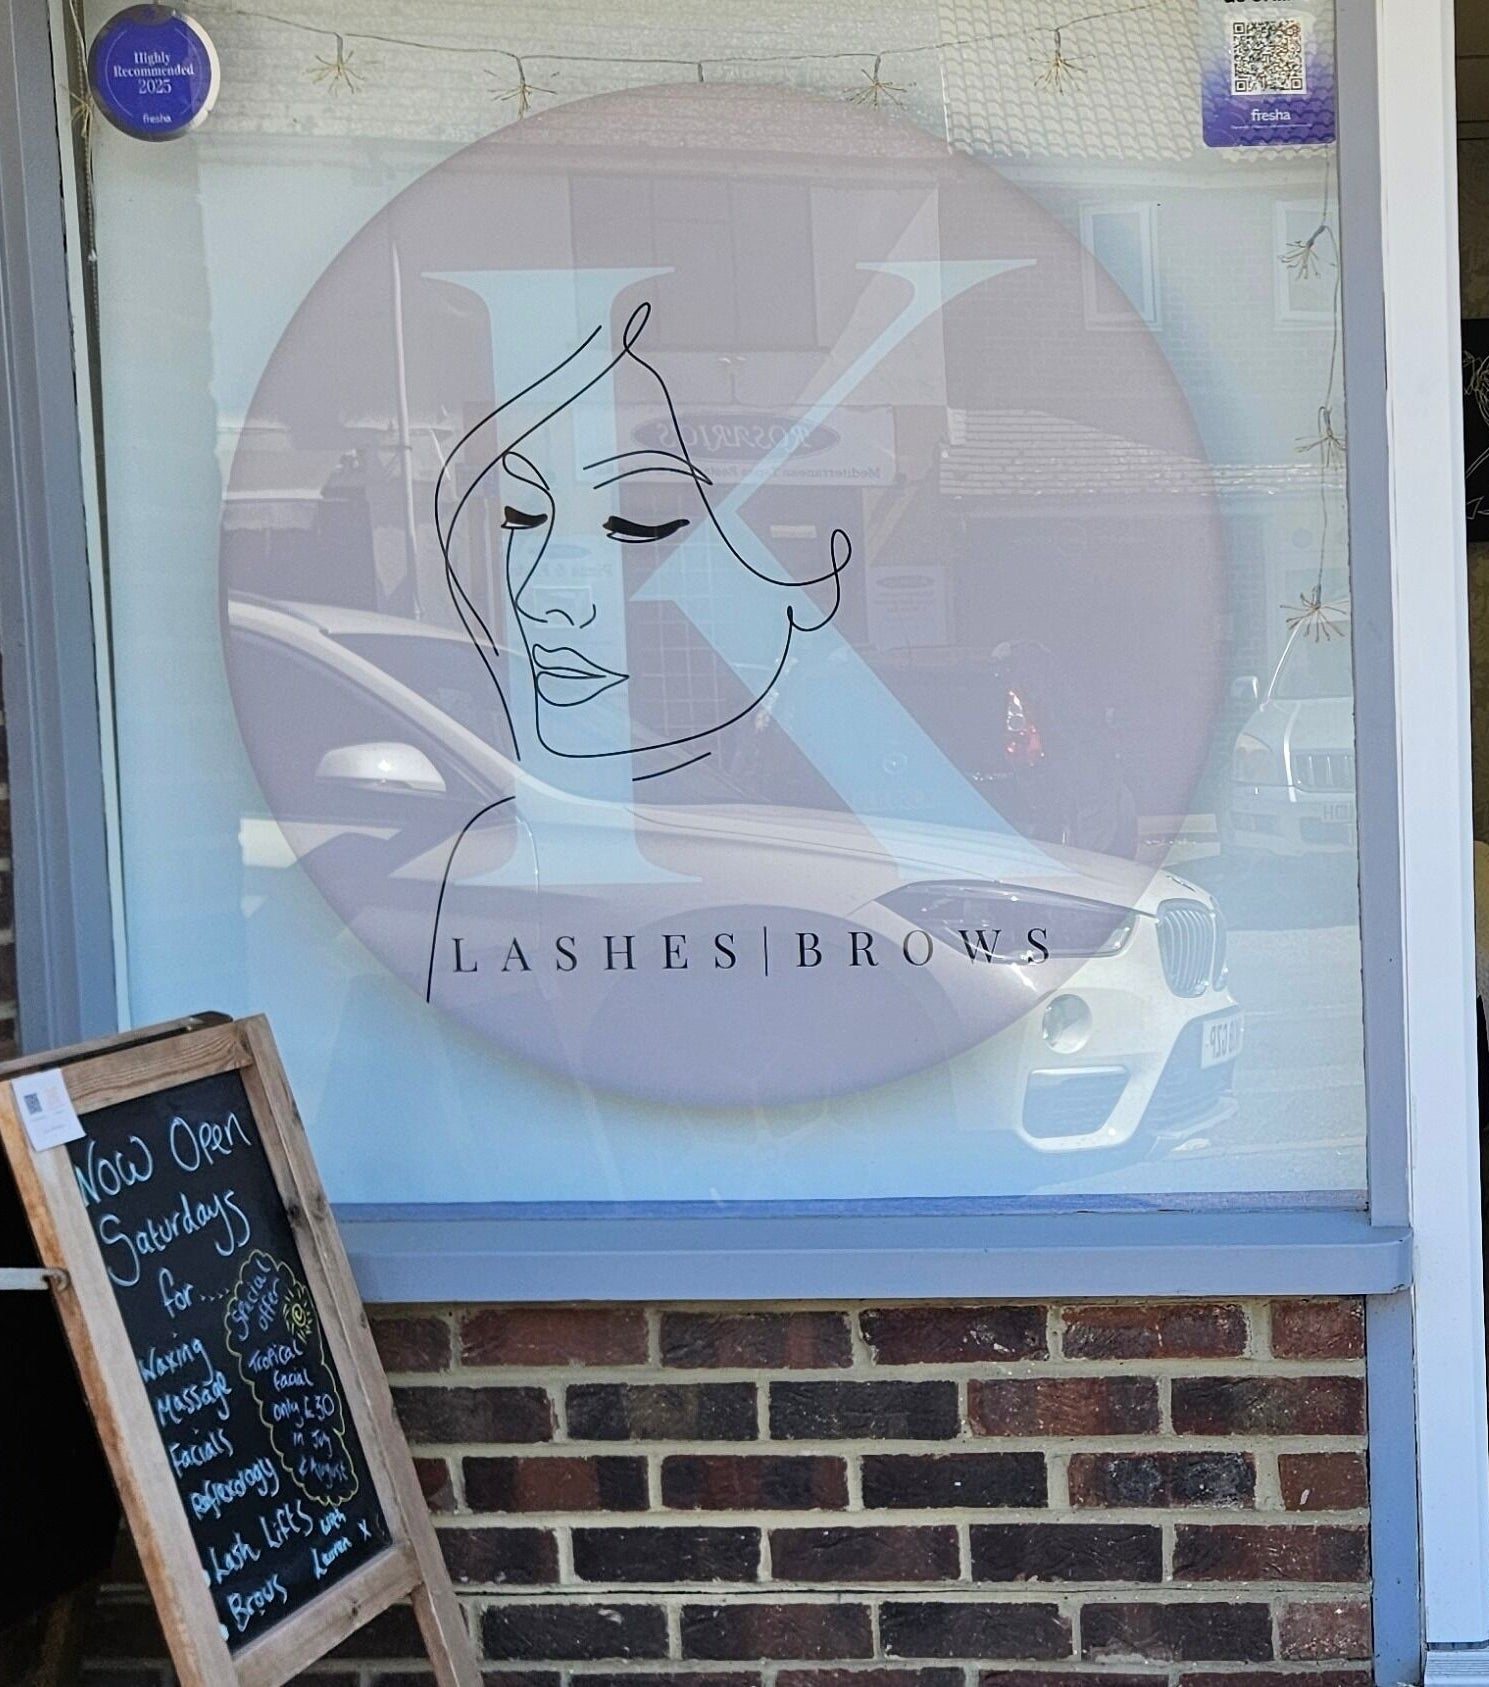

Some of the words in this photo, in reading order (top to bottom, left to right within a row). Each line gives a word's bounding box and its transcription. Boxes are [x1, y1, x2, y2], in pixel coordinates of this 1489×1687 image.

[113, 63, 194, 78] Recommended
[134, 50, 170, 66] Highly
[138, 78, 172, 95] 2025
[1250, 108, 1292, 122] fresha
[452, 932, 737, 973] LASHES
[795, 927, 1050, 968] BROWS
[100, 1188, 251, 1287] Saturdays
[258, 1277, 281, 1331] offer
[138, 1333, 213, 1386] Waxing
[156, 1371, 232, 1427] Massage
[169, 1428, 234, 1479] Facials
[208, 1531, 261, 1585] Lash
[260, 1499, 313, 1549] Lifts
[226, 1573, 288, 1633] Brows
